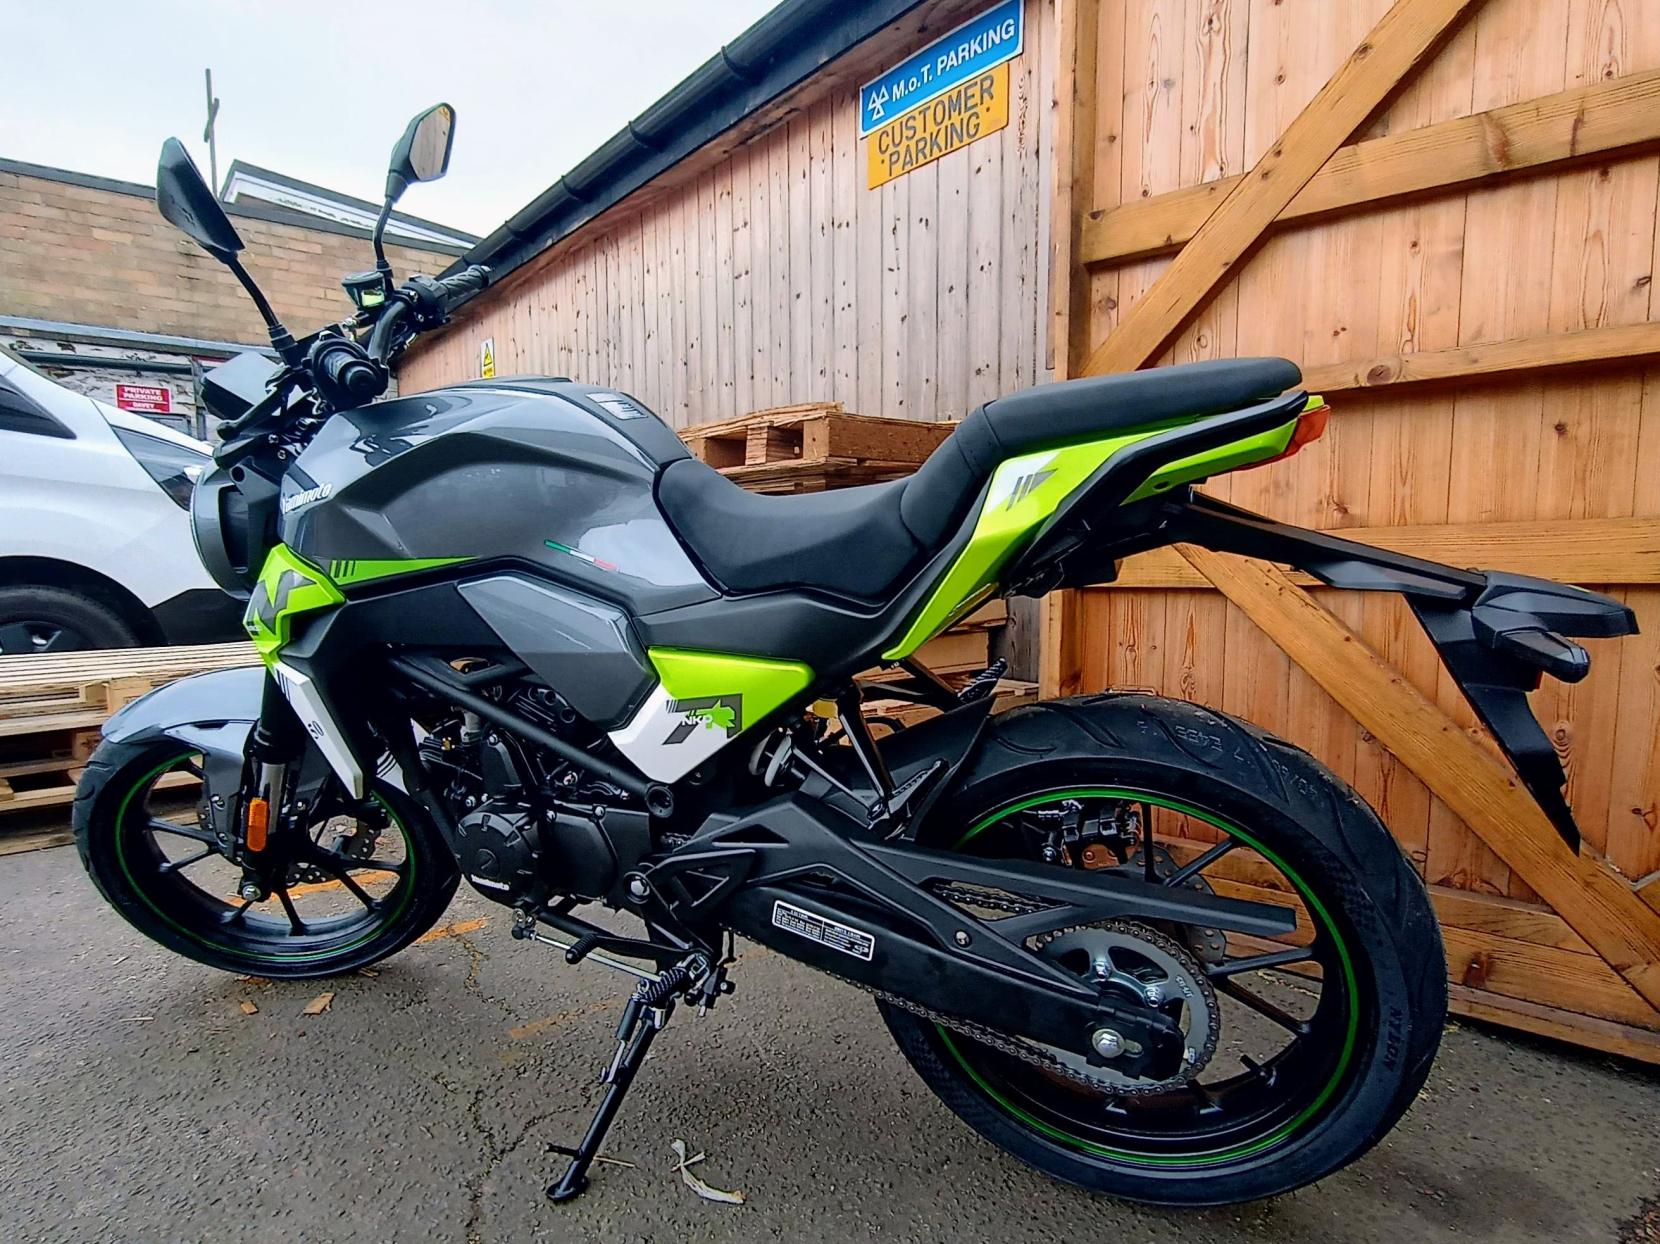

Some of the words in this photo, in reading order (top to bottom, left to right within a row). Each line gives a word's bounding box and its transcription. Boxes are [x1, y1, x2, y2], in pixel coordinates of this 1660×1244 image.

[937, 18, 1016, 76] PARKING
[878, 74, 994, 155] CUSTOMER
[889, 111, 980, 177] PARKING
[123, 392, 163, 401] PARKING
[124, 386, 161, 395] PRIVATE
